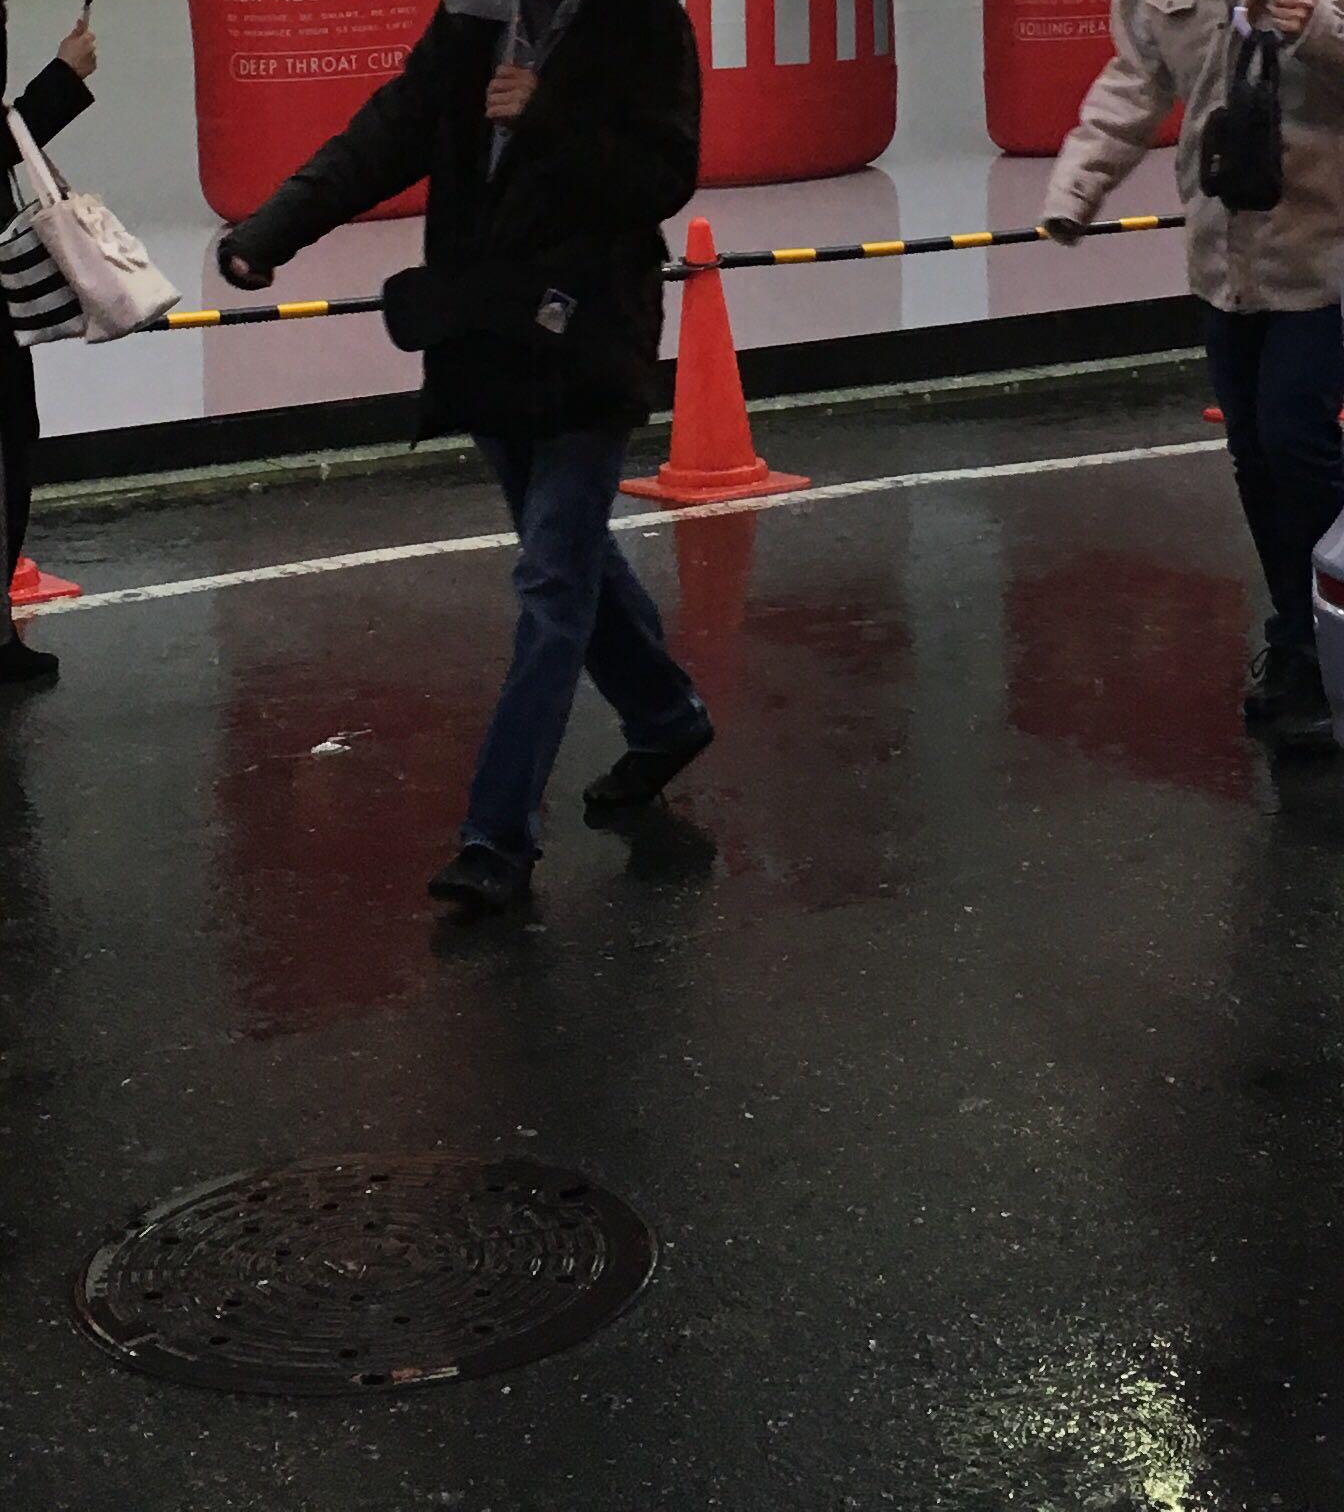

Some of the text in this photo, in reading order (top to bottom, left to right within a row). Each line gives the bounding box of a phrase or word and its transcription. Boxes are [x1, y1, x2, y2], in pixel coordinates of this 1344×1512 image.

[1077, 19, 1108, 34] HEA
[239, 51, 404, 76] DEEP THROAT CUP
